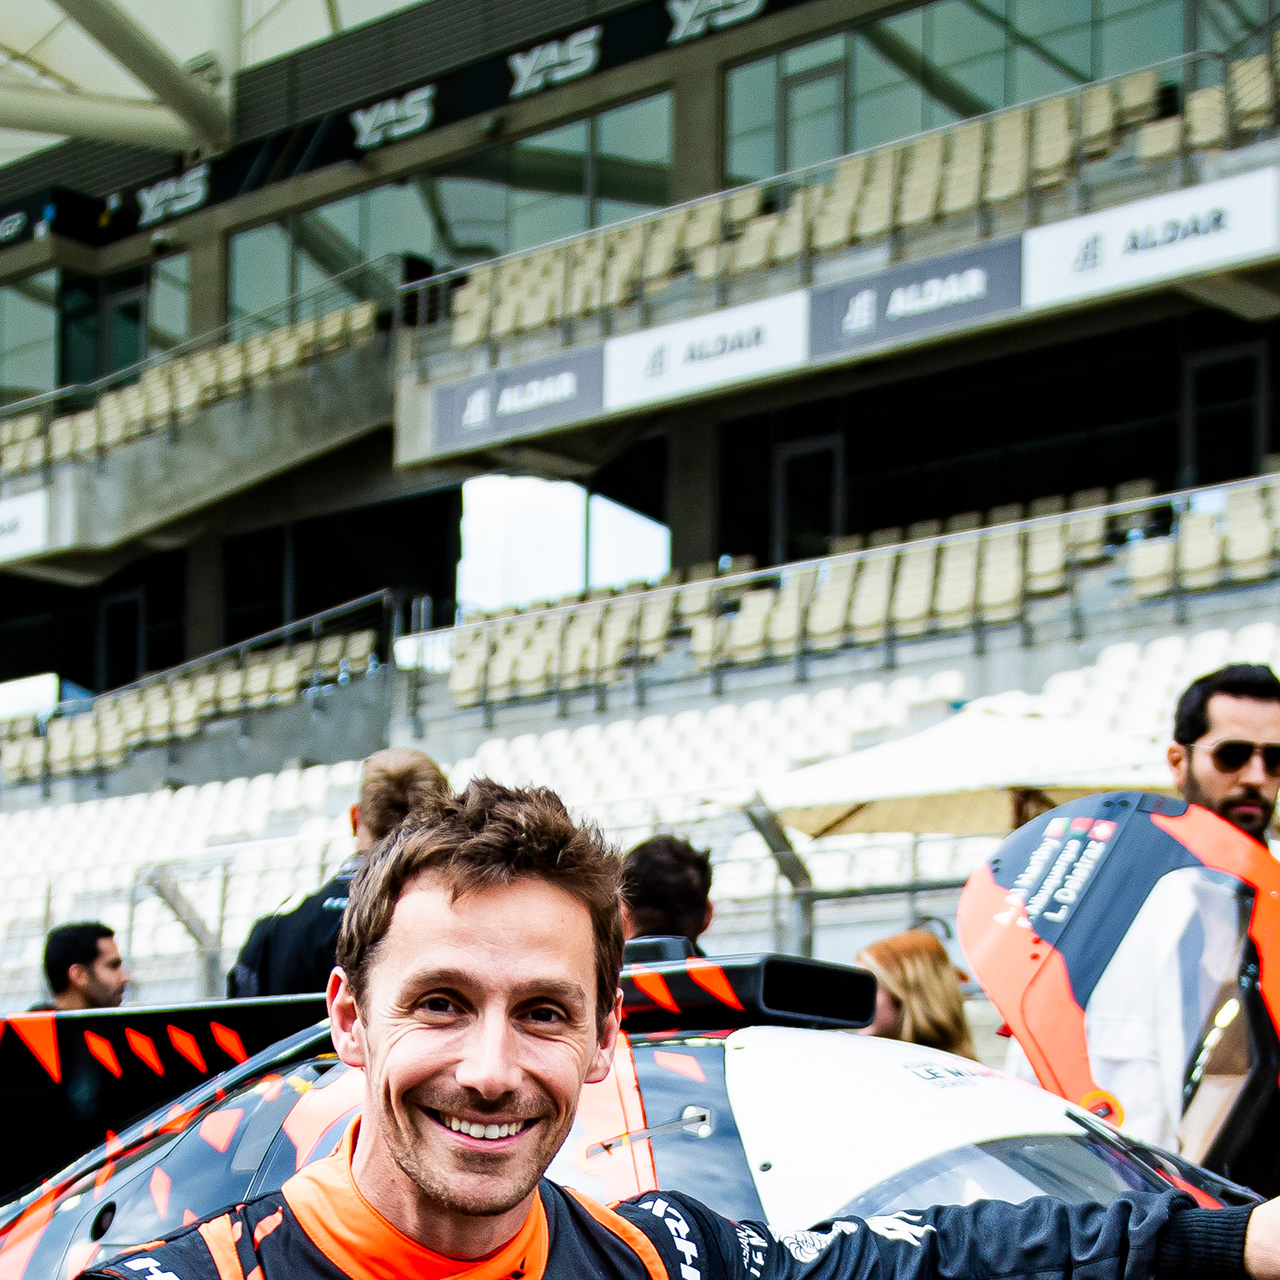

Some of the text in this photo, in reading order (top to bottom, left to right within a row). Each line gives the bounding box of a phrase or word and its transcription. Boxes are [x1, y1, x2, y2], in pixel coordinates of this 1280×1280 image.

[506, 24, 604, 98] YAS
[349, 83, 439, 148] YAS
[136, 162, 211, 226] YAS
[1121, 207, 1229, 255] ALDAR
[884, 268, 988, 321] ALDAR
[682, 325, 766, 366] ALDAR
[496, 370, 578, 416] ALDAR
